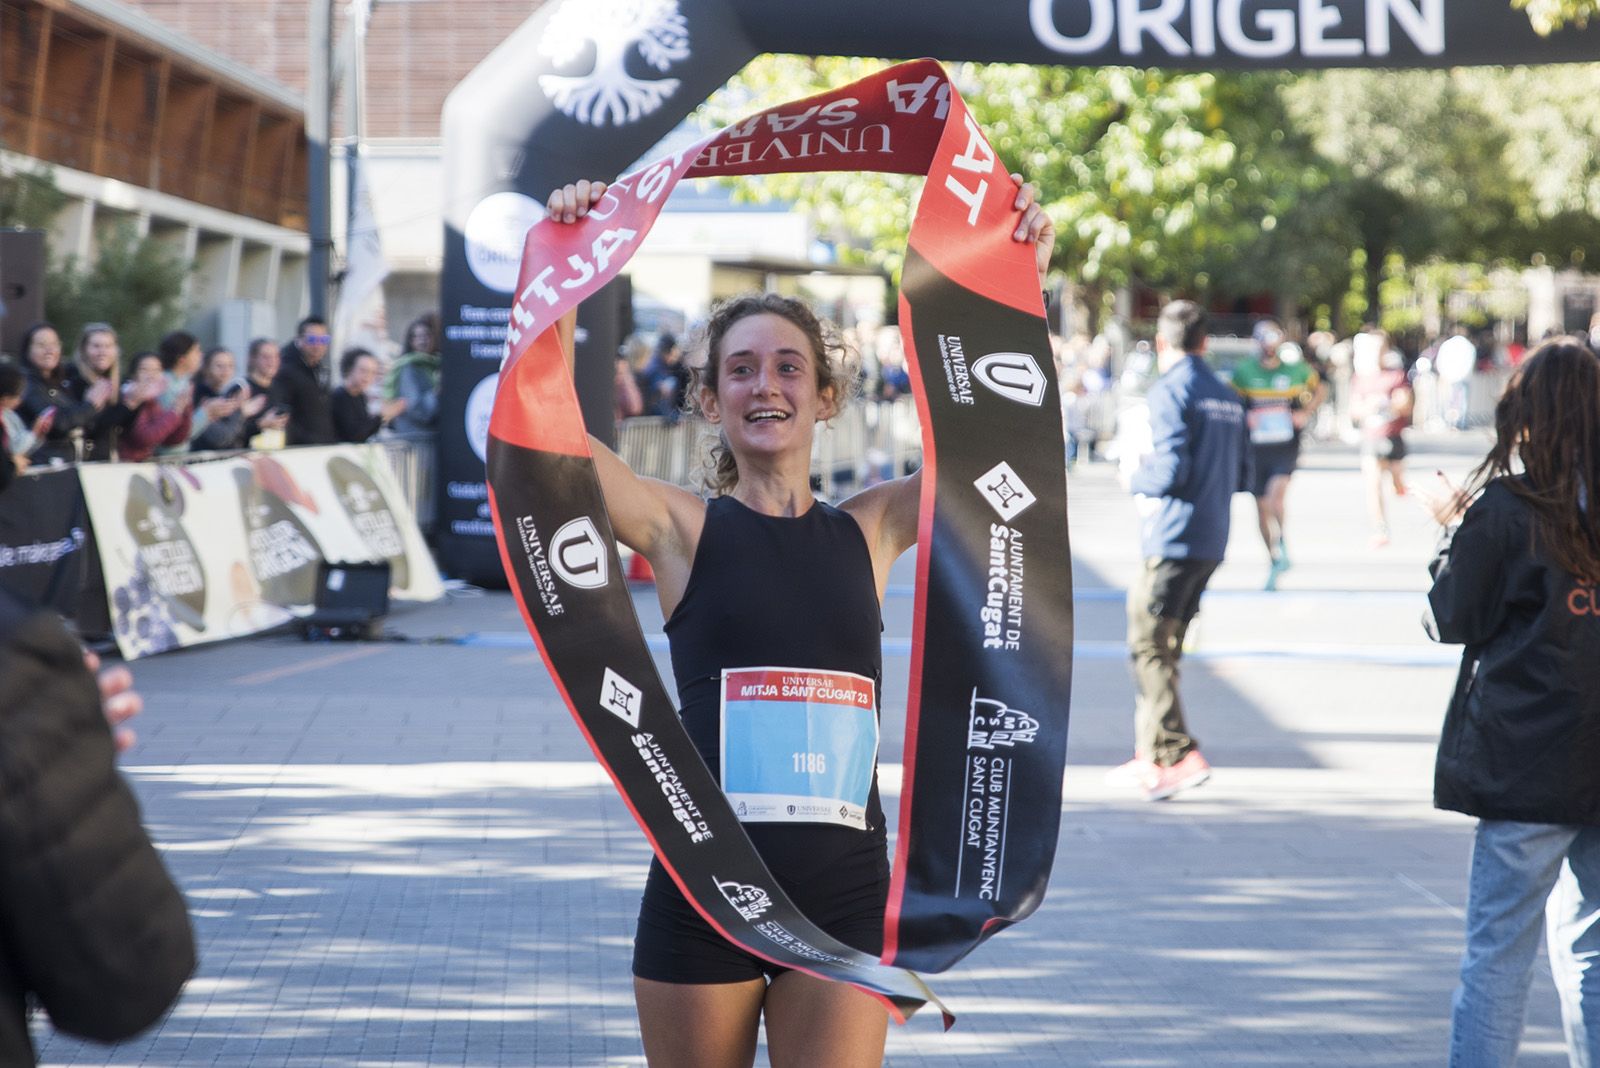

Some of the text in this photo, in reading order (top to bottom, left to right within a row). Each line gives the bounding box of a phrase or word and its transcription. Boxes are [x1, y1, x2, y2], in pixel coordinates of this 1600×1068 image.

[1028, 0, 1446, 57] ORIGEN
[947, 336, 975, 405] UNIVERSAE
[516, 517, 531, 554] Instituto
[527, 554, 542, 590] Superior
[523, 515, 565, 615] UNIVERSAE
[1005, 527, 1024, 650] AJUNTAMENT DE
[740, 685, 868, 704] MITJA SANT CUGAT 23
[782, 676, 834, 687] UNIVERSAE
[643, 732, 714, 840] AJUNTAMENT DE
[792, 752, 826, 774] 1186
[967, 756, 987, 848] SANT CUGAT
[978, 757, 1004, 900] CLUB MUNTANYENC
[757, 923, 788, 951] SANT
[766, 920, 794, 943] CLUB
